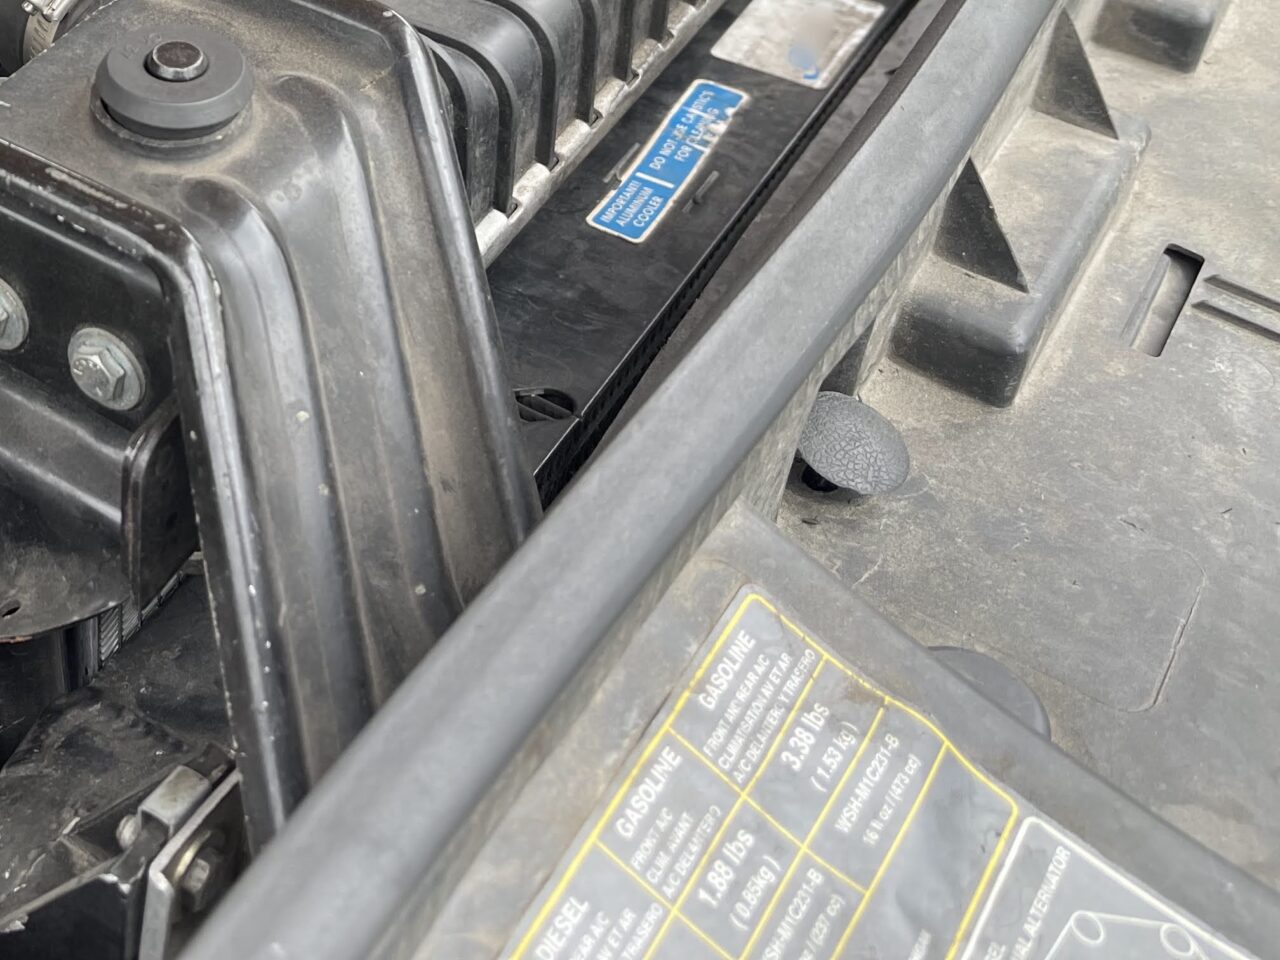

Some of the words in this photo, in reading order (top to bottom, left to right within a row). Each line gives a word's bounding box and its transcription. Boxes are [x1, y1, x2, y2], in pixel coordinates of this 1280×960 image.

[649, 155, 666, 170] DO
[674, 145, 692, 162] FOR
[617, 185, 653, 226] ALUMINUM
[634, 195, 663, 228] COOLER
[698, 630, 756, 710] GASOLINE
[735, 671, 759, 702] REAR
[761, 682, 774, 698] AV
[769, 666, 783, 684] ET
[777, 652, 791, 671] AR
[780, 726, 816, 771] 3.38
[802, 701, 830, 731] lbs
[615, 746, 681, 838] GASOLINE
[836, 735, 899, 832] WSH-M1C231-B
[879, 804, 892, 820] oz
[888, 772, 910, 800] (473
[697, 859, 735, 906] 1.88
[721, 827, 755, 864] lbs
[1021, 845, 1071, 936] ALTERNATOR
[534, 897, 589, 960] DIESEL
